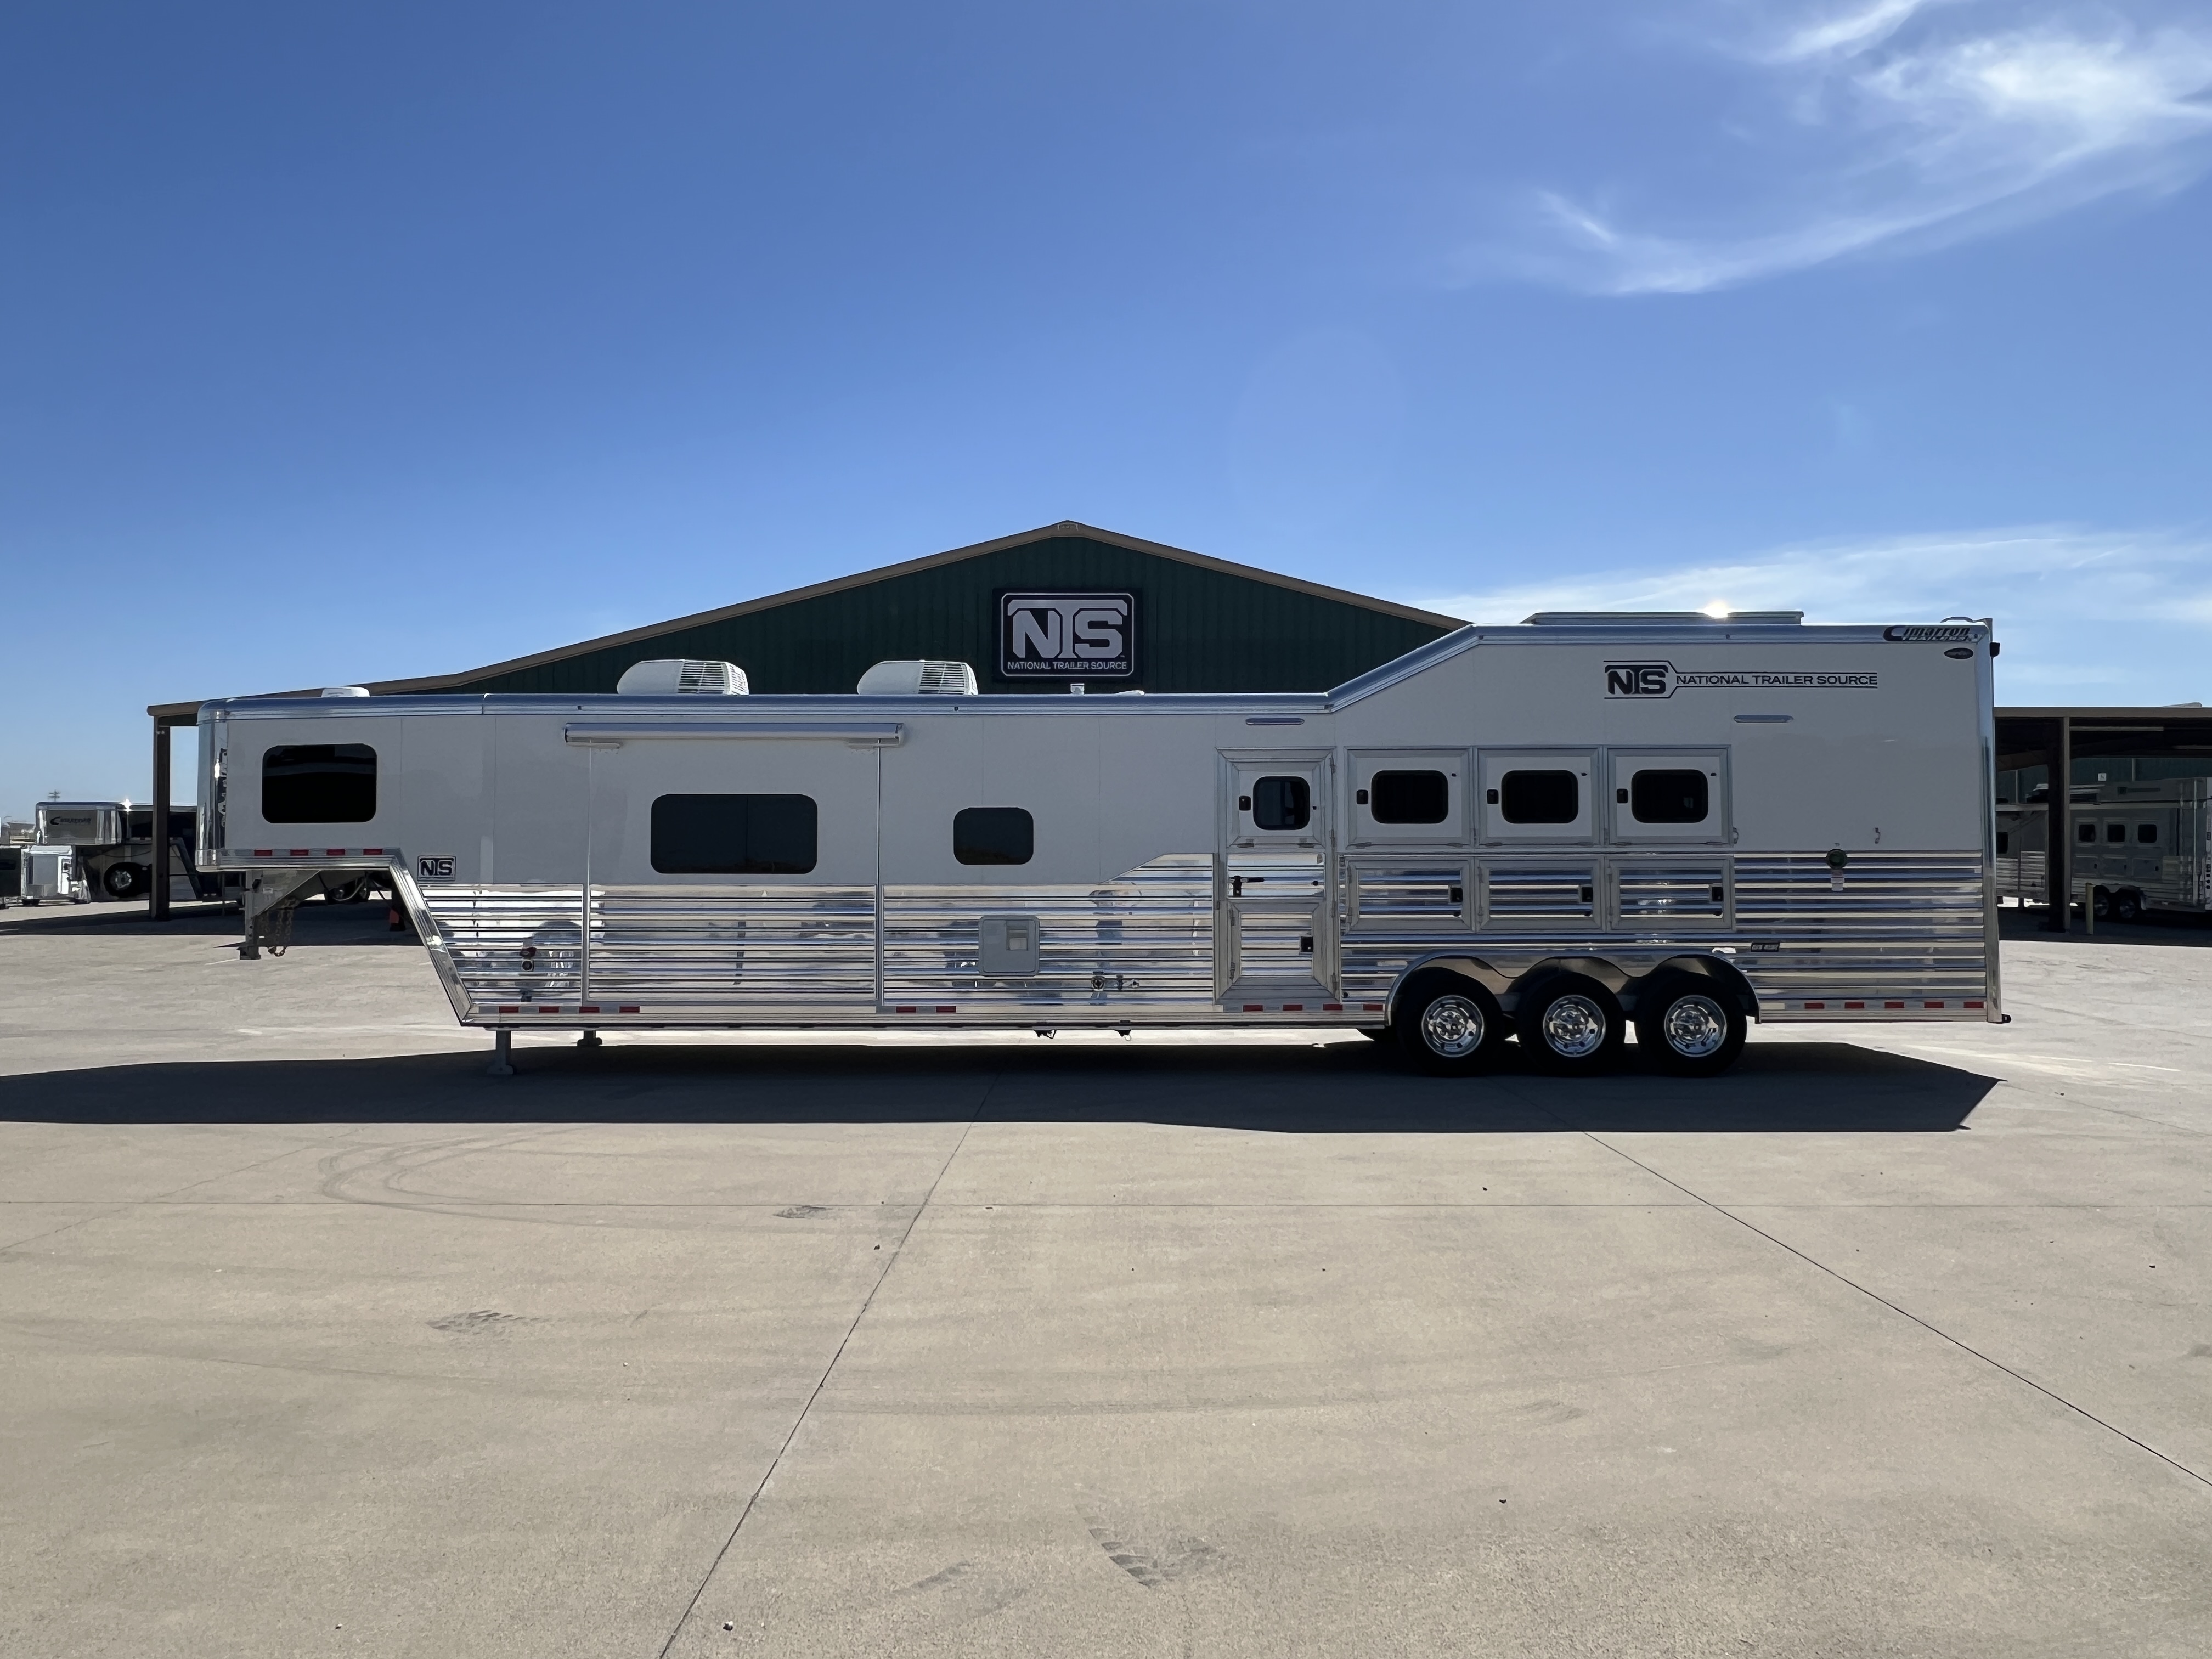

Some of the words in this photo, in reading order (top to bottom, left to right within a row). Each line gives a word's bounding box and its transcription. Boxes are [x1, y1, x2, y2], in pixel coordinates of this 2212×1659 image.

[1008, 600, 1127, 658] NTS
[1605, 665, 1669, 695] NTS
[1677, 675, 1749, 685] NATIONAL
[1752, 675, 1813, 685] TRAILER
[1817, 675, 1878, 685] SOURCE
[420, 858, 454, 876] NTS
